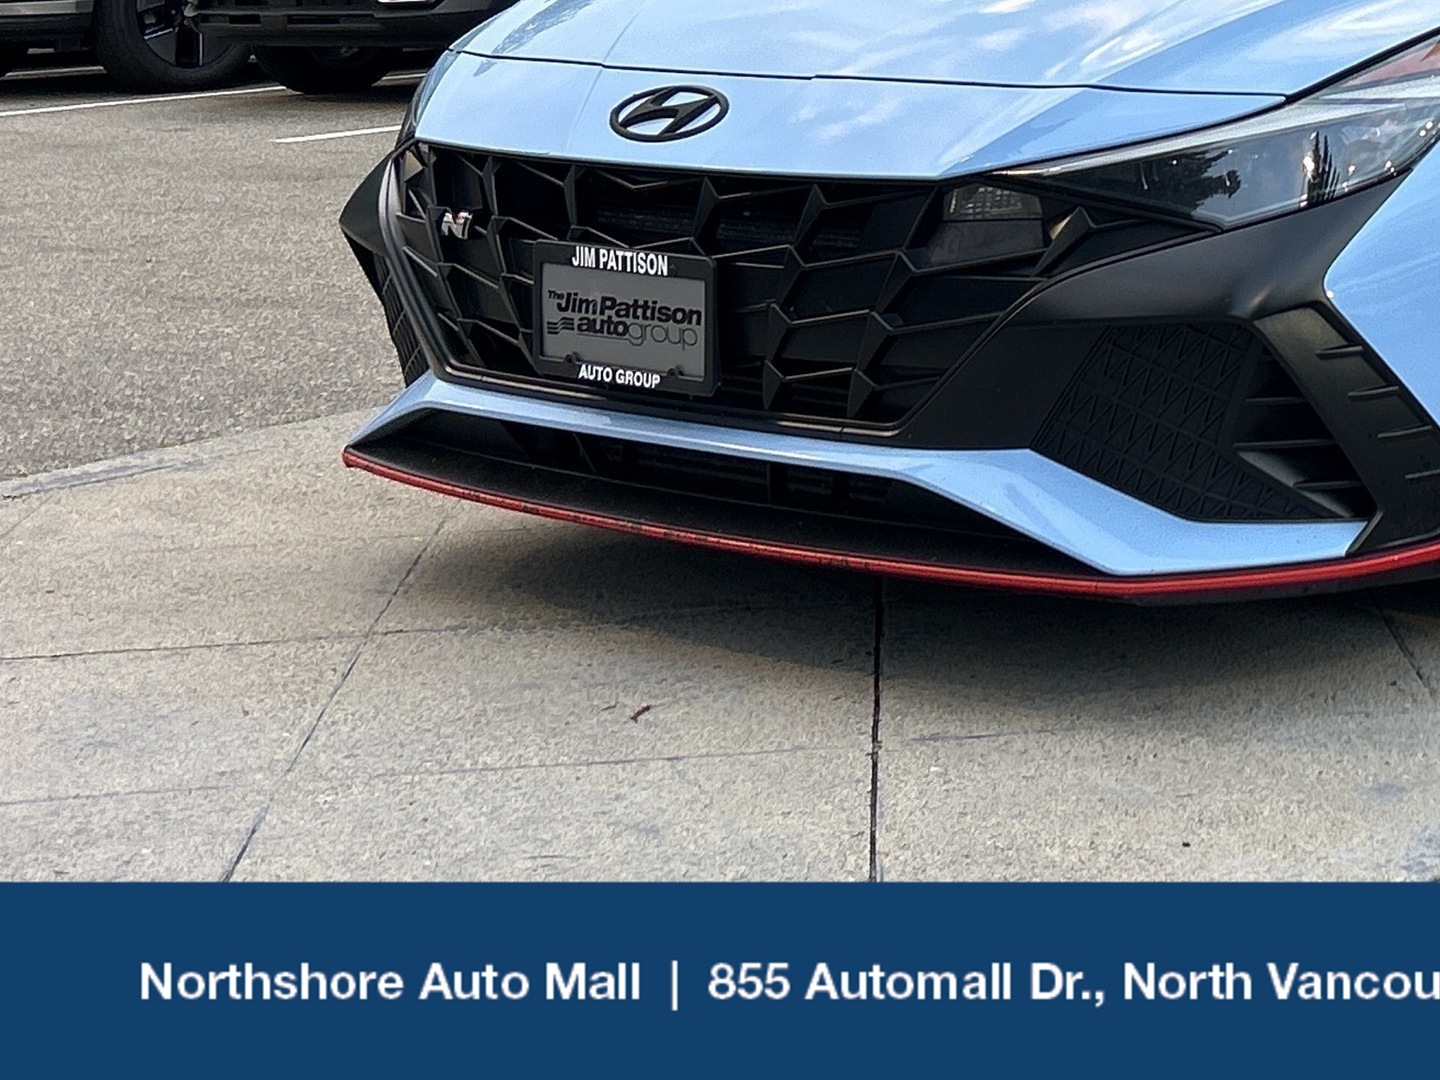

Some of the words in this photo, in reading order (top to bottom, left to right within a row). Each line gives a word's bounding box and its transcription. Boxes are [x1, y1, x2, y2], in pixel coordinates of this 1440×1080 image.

[571, 245, 596, 268] JIM
[599, 248, 669, 276] PATTISON
[577, 363, 613, 383] AUTO
[615, 368, 662, 389] GROUP
